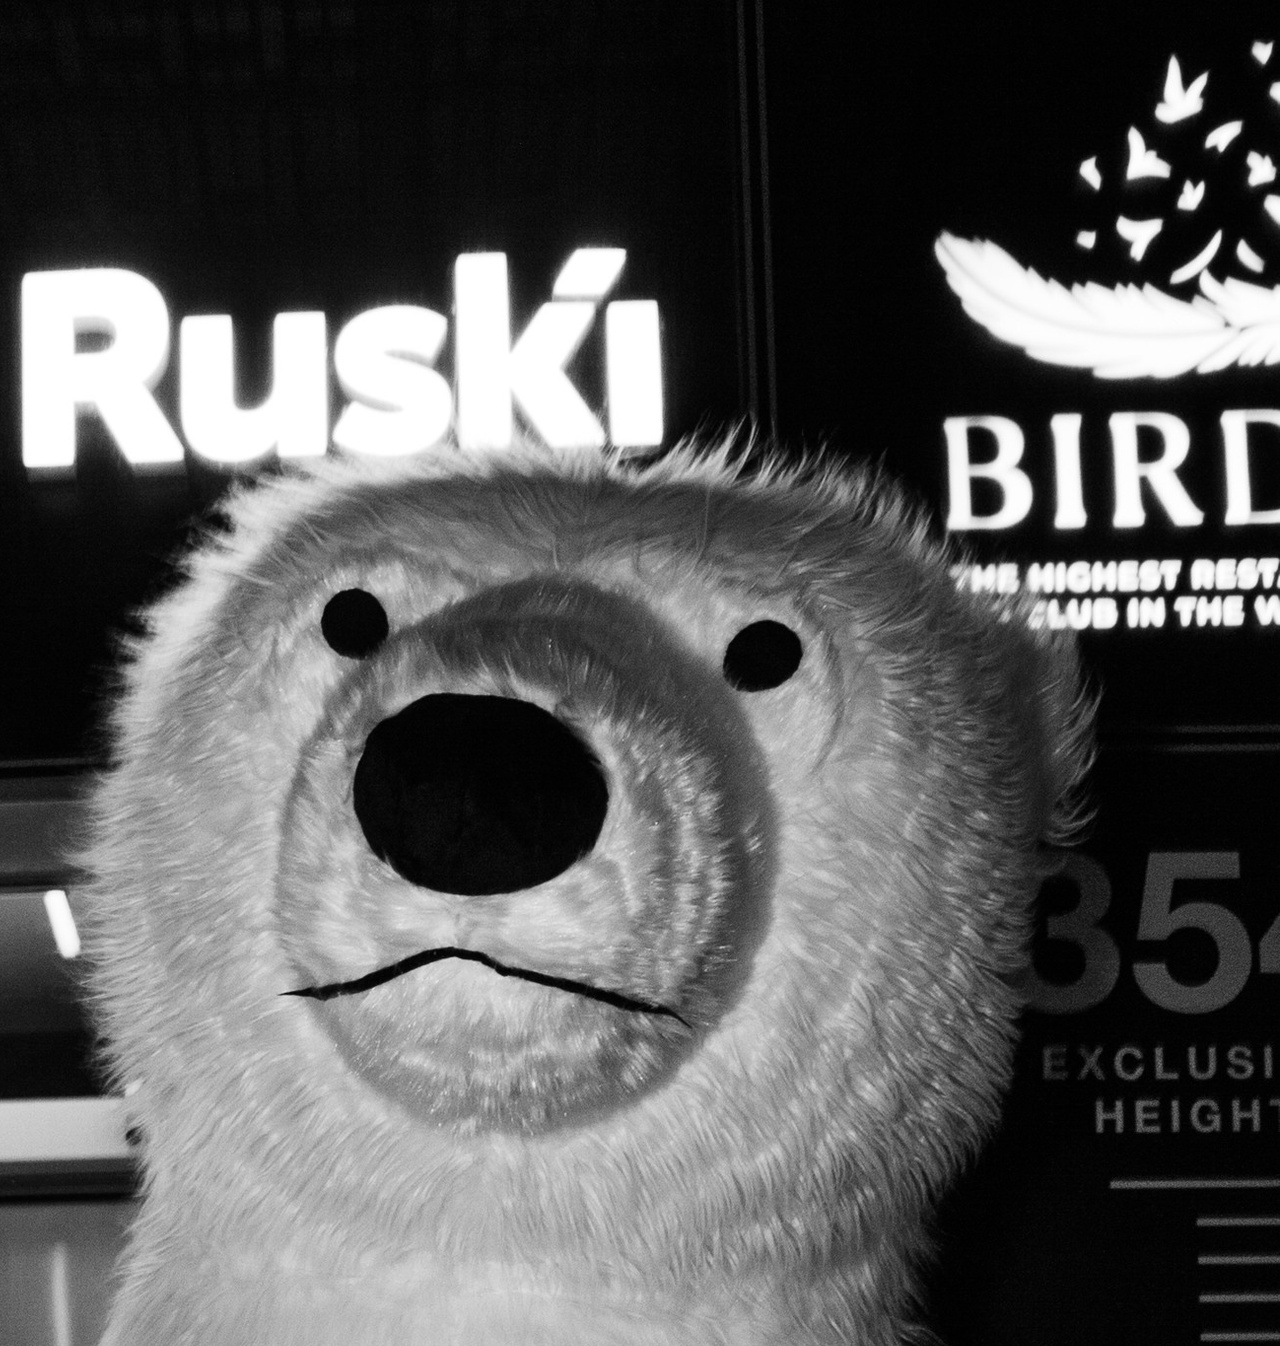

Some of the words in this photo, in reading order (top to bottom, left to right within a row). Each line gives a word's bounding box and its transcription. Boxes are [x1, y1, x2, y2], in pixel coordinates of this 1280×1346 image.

[1026, 560, 1182, 593] HIGHEST
[1190, 557, 1280, 590] REST
[1126, 596, 1166, 628] IN
[1174, 595, 1245, 627] THE
[1007, 851, 1280, 1015] 35
[1041, 1044, 1274, 1081] EXCLUSI
